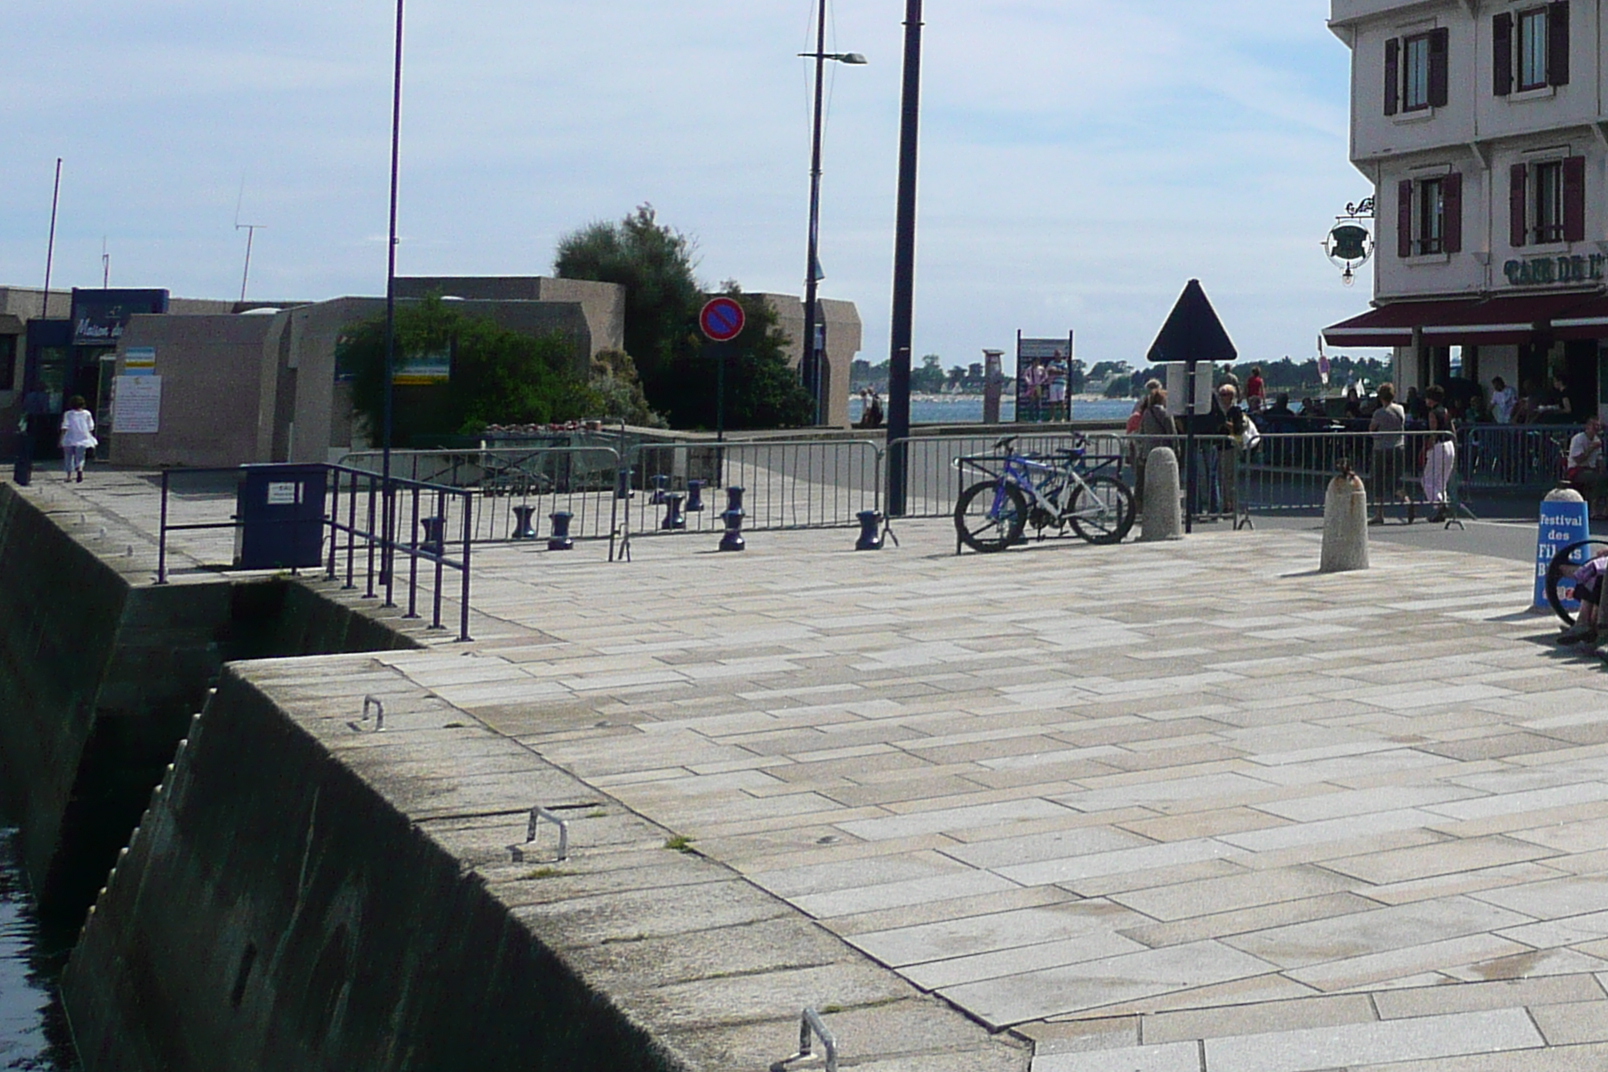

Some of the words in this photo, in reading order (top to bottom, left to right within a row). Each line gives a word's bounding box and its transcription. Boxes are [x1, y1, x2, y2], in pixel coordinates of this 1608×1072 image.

[1557, 254, 1584, 282] DE
[1540, 514, 1582, 526] Festival
[1548, 529, 1570, 540] des
